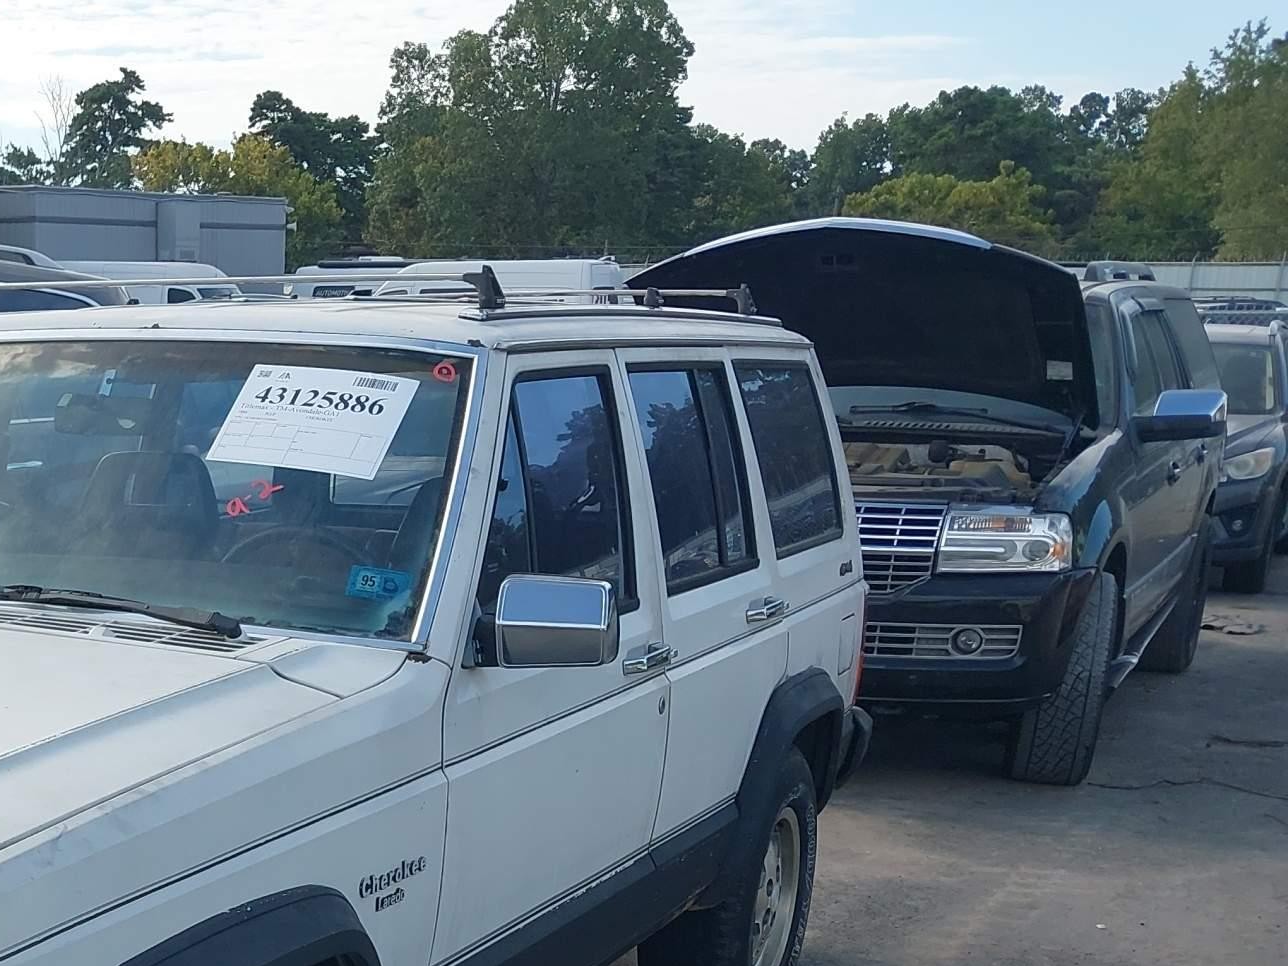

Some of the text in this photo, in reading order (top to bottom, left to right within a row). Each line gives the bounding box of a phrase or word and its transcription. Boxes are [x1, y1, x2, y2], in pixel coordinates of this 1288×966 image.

[255, 386, 390, 416] 43125886
[360, 574, 376, 587] 95
[358, 856, 426, 899] Cherokee
[374, 887, 405, 912] Laredo
